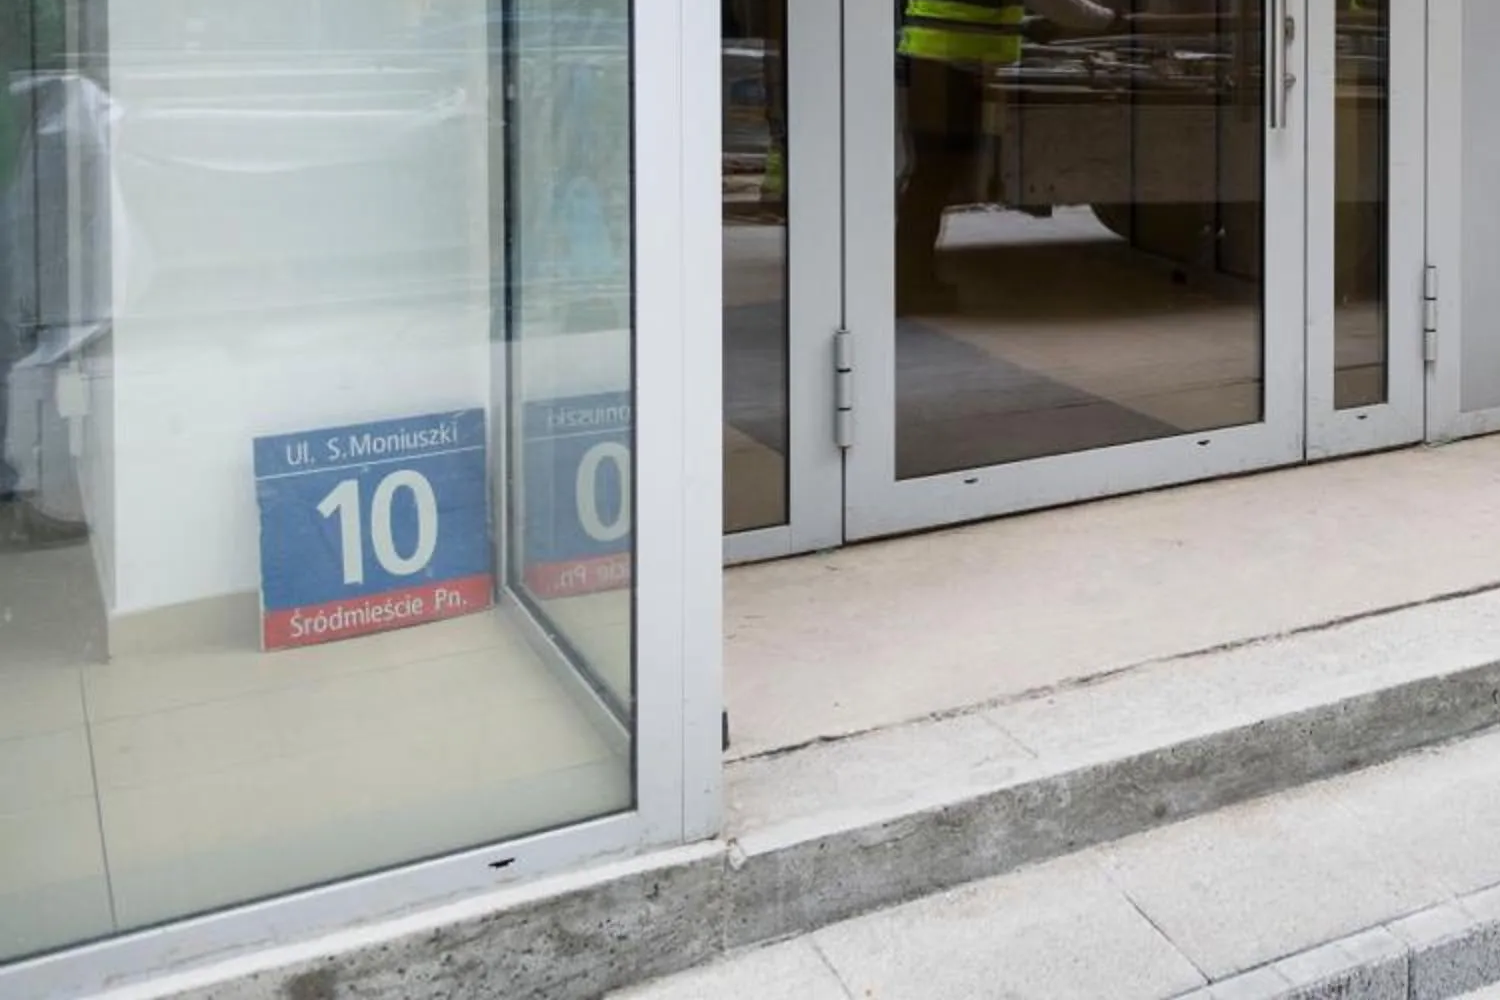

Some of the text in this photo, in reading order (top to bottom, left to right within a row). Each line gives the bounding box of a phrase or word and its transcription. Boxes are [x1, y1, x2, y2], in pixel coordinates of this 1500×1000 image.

[286, 440, 316, 466] Ul.
[316, 469, 438, 585] 10
[289, 588, 468, 638] Śródmieście Pn.
